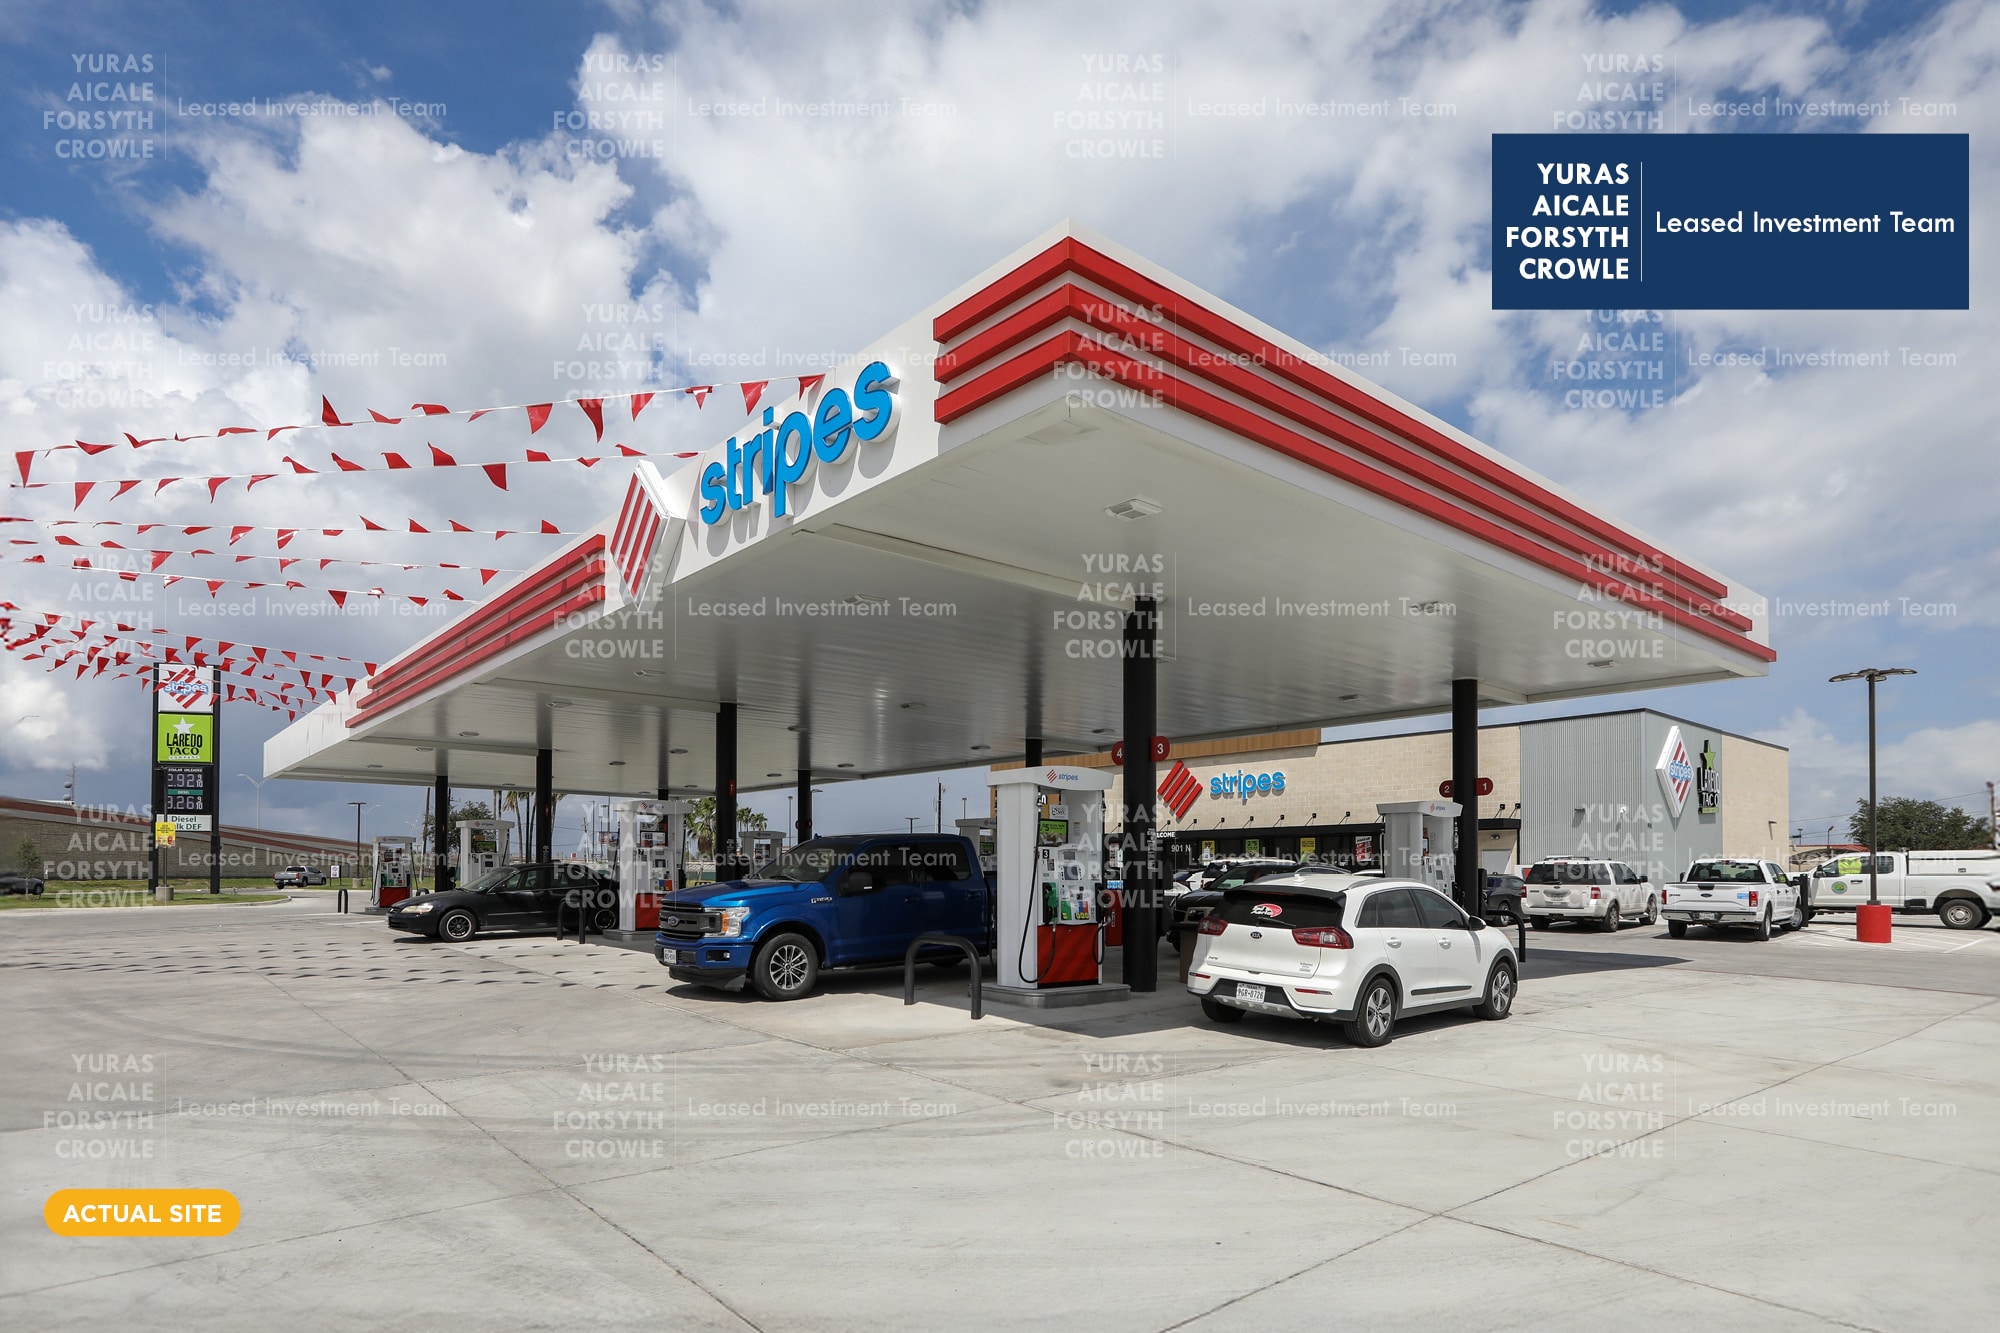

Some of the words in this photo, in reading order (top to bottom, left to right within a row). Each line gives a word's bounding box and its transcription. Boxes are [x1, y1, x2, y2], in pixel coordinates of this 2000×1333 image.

[700, 361, 898, 526] stripes
[166, 732, 202, 748] LAREDO
[168, 747, 200, 756] TACO
[1116, 748, 1123, 758] 4
[1157, 743, 1164, 754] 3
[1058, 773, 1079, 782] stripes
[1210, 769, 1286, 800] stripes
[1702, 792, 1720, 806] TACO
[1171, 844, 1182, 852] 901
[1186, 844, 1191, 852] N
[1043, 850, 1048, 858] 3
